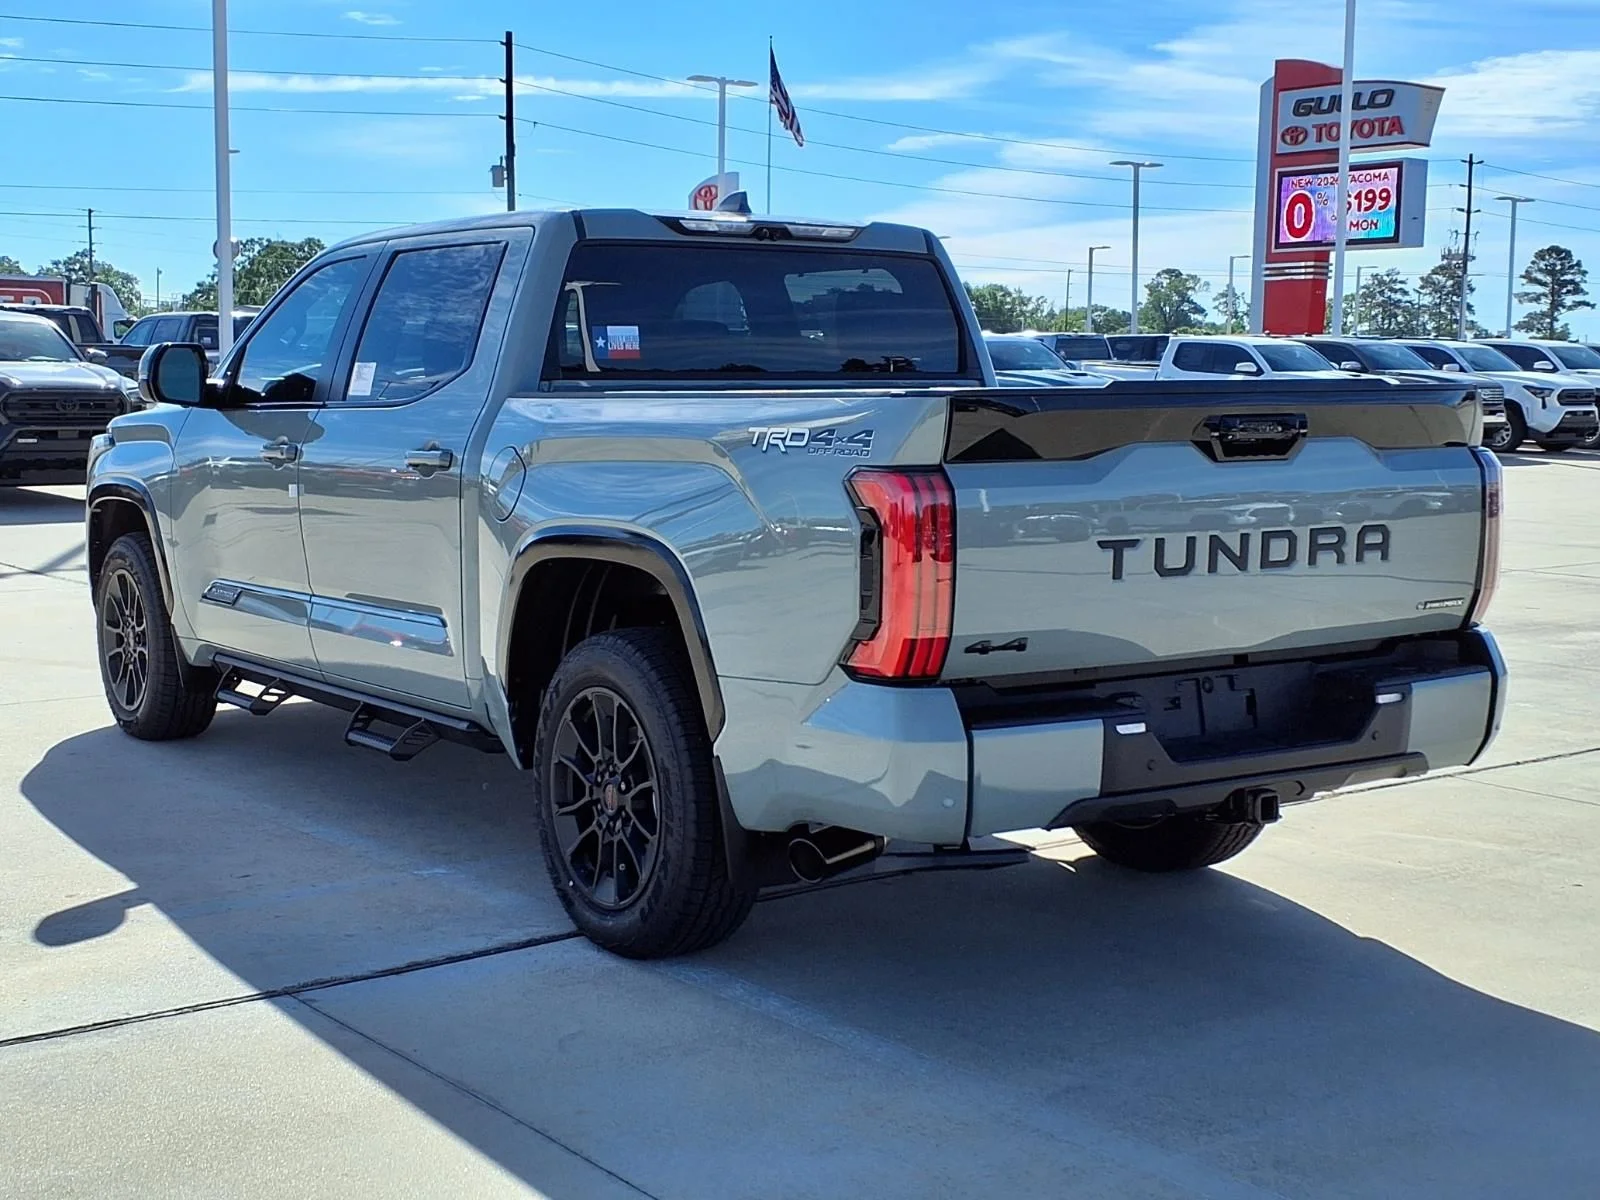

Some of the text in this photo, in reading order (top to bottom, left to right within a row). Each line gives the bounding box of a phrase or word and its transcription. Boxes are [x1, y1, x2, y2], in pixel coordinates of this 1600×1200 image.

[1292, 88, 1395, 117] GULO
[1290, 178, 1313, 189] NEW
[748, 427, 811, 453] TRD
[808, 447, 870, 458] OFF ROAD
[1097, 523, 1391, 581] TUNDRA
